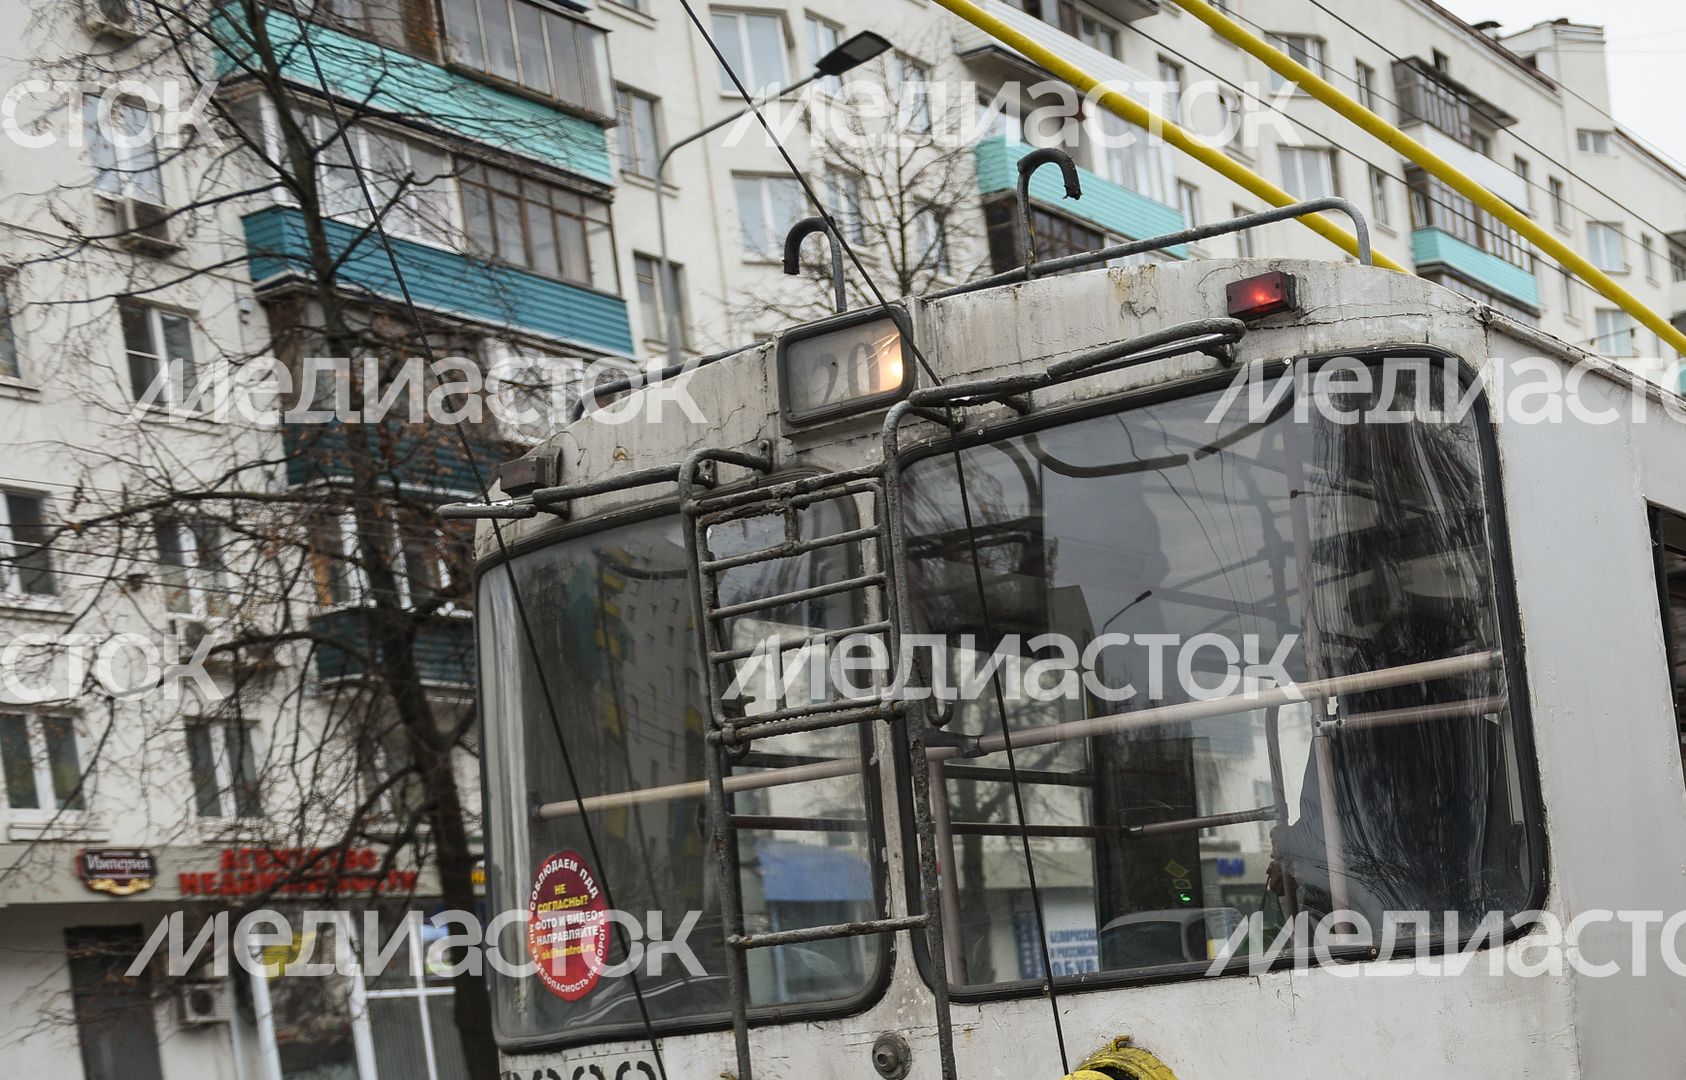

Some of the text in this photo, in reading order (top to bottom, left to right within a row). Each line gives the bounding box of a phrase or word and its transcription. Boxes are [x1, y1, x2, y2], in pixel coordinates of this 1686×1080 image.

[530, 858, 599, 911] СОБЛЮДАЕМ ПДД
[554, 884, 567, 895] НЕ
[537, 895, 588, 914] СОГЛАСНЫ?
[535, 910, 597, 930] ФОТО И ВИДЕО
[537, 925, 599, 945] НАПРАВЛЯЙТЕ
[537, 963, 589, 993] БЕЗОПАСНОСТЬ
[595, 911, 605, 964] ДОРОГАХ
